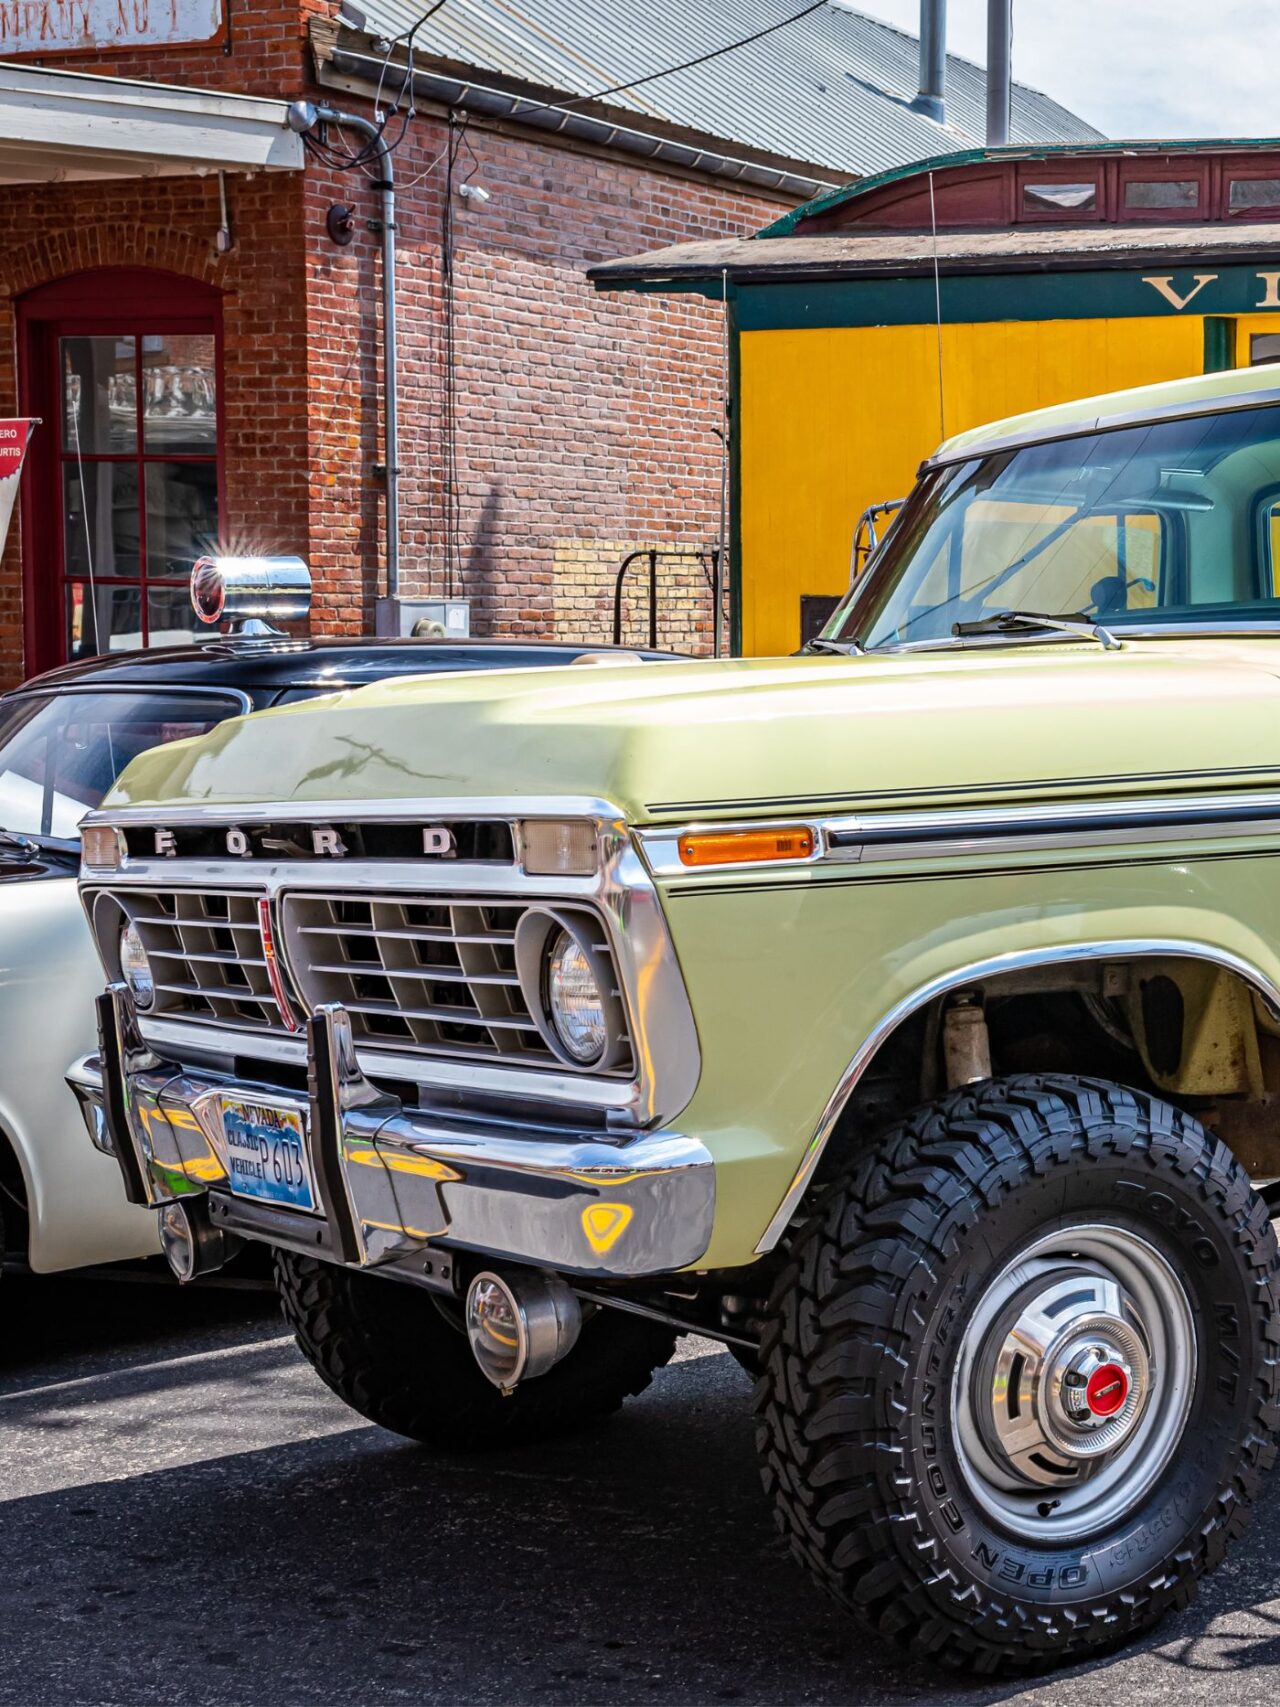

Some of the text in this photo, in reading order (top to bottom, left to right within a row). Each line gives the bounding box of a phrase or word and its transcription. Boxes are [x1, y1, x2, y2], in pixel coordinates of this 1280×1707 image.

[154, 828, 455, 856] FORD
[242, 1104, 281, 1128] NEVADA
[228, 1130, 259, 1151] CLASSIC
[231, 1156, 262, 1179] VEHICLE
[970, 1541, 1089, 1591] OPEN
